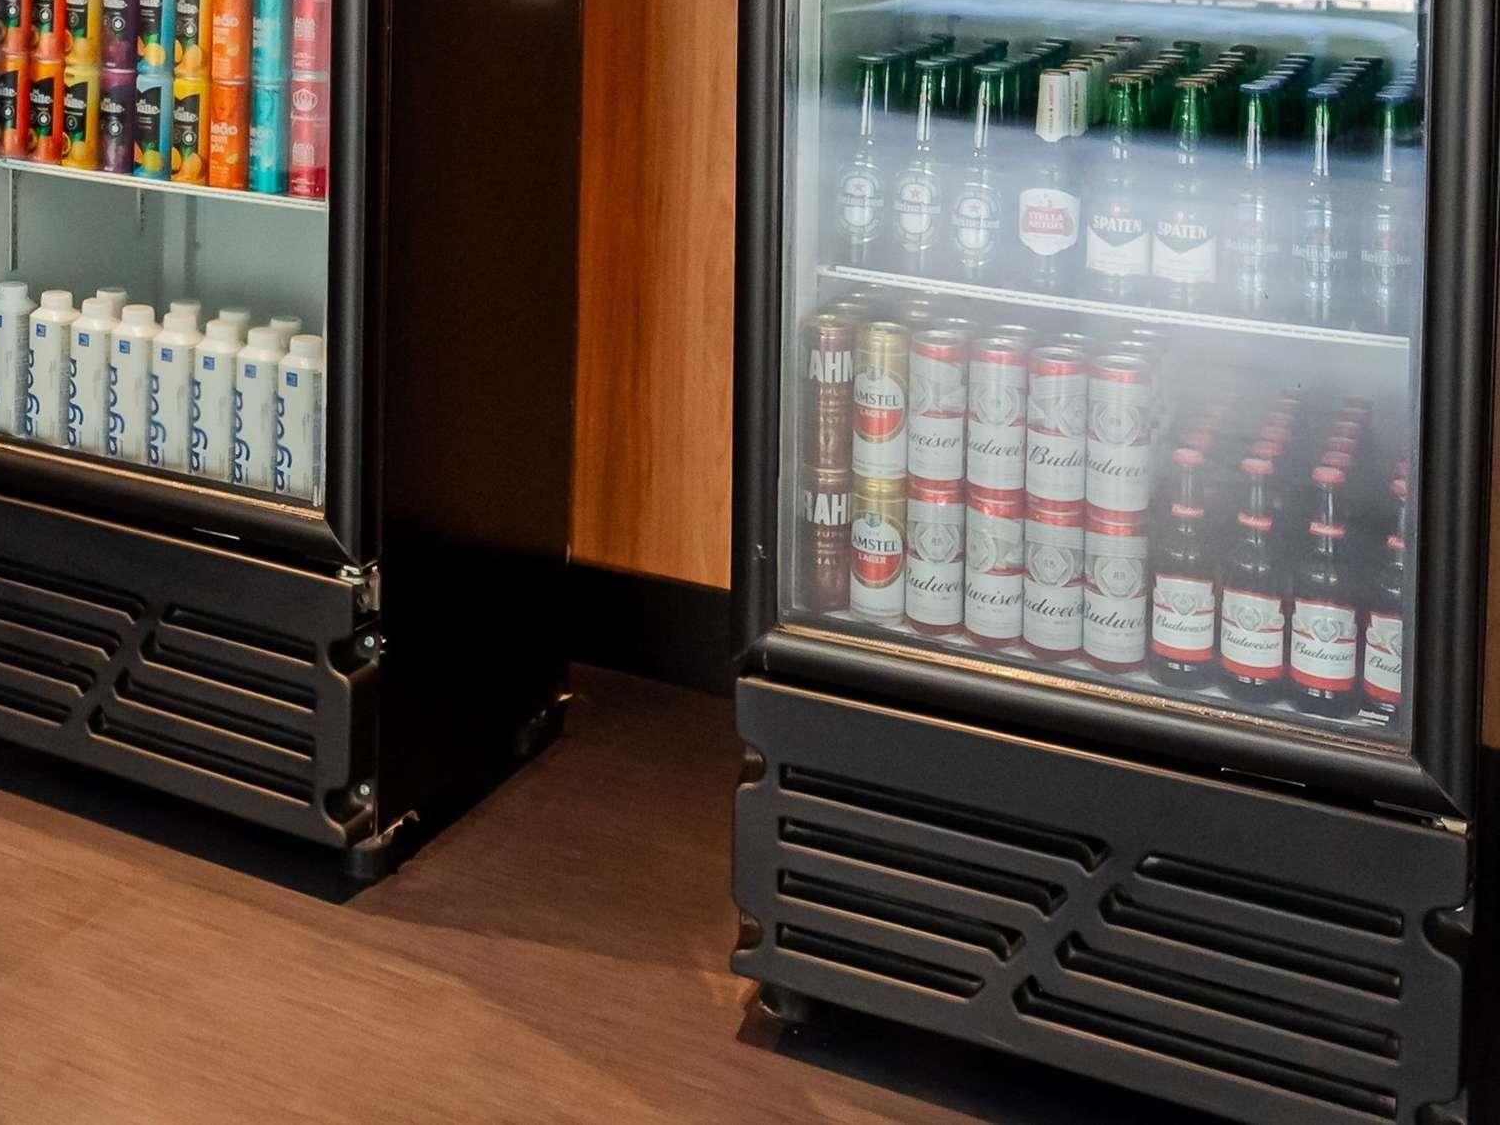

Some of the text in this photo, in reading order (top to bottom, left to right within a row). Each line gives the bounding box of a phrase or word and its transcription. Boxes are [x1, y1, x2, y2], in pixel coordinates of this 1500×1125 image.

[1092, 214, 1142, 234] SPATEN
[1157, 221, 1207, 240] SPATEN
[1222, 629, 1280, 651] Budweiser
[1293, 640, 1354, 662] Budweiser
